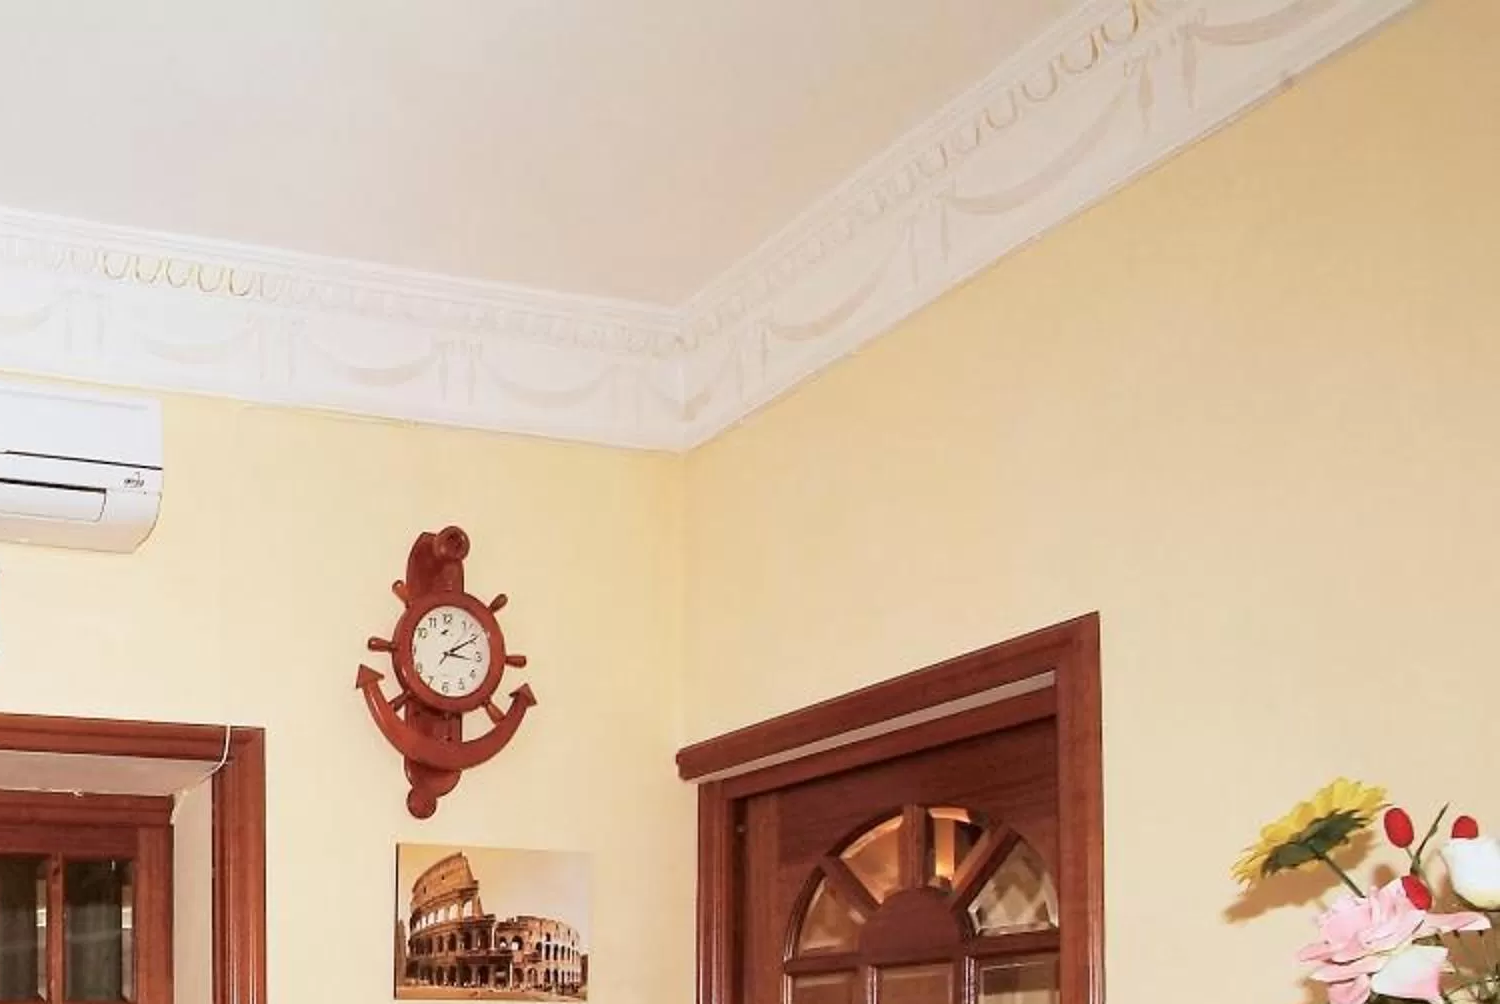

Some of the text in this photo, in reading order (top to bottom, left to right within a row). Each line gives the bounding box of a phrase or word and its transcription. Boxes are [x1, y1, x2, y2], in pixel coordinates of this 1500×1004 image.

[428, 617, 437, 629] 11
[442, 613, 453, 625] 12
[475, 651, 482, 662] 3
[441, 681, 449, 693] 6
